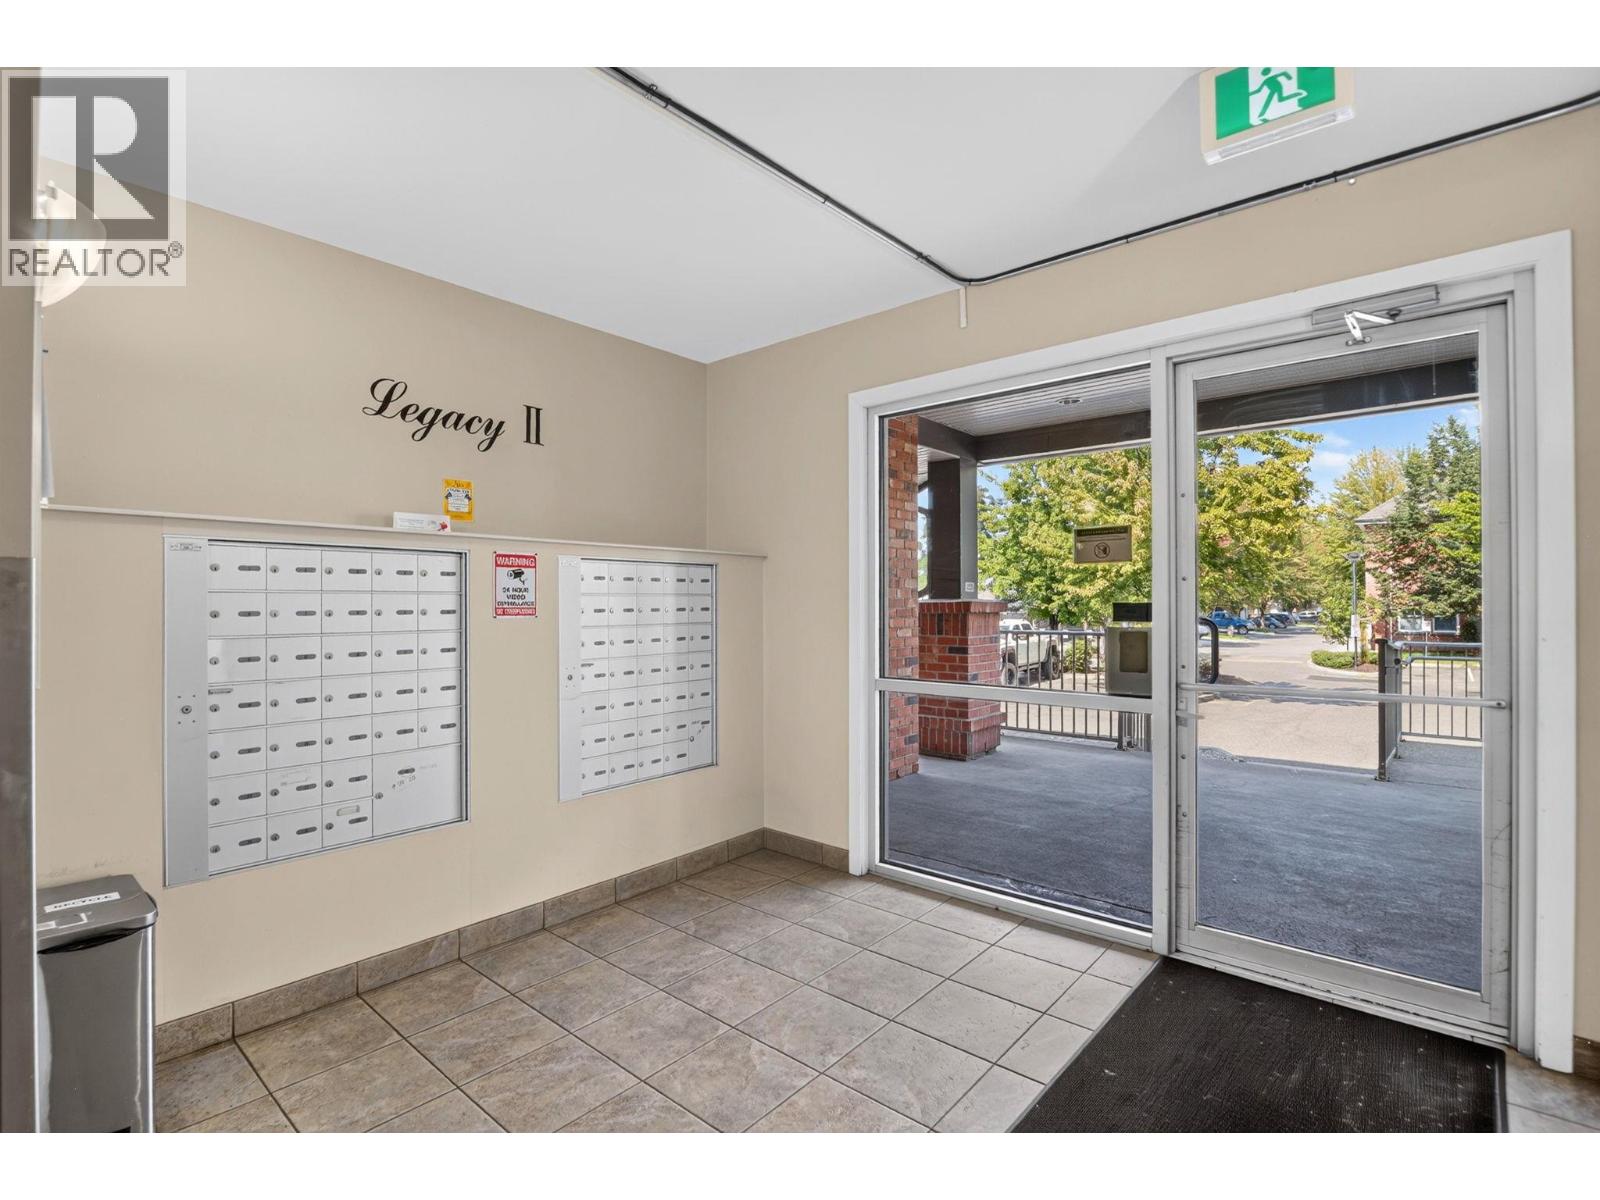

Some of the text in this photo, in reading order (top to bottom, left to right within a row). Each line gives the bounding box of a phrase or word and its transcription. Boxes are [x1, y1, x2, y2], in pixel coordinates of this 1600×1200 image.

[362, 378, 545, 452] Legacy II
[496, 556, 536, 567] WARNING
